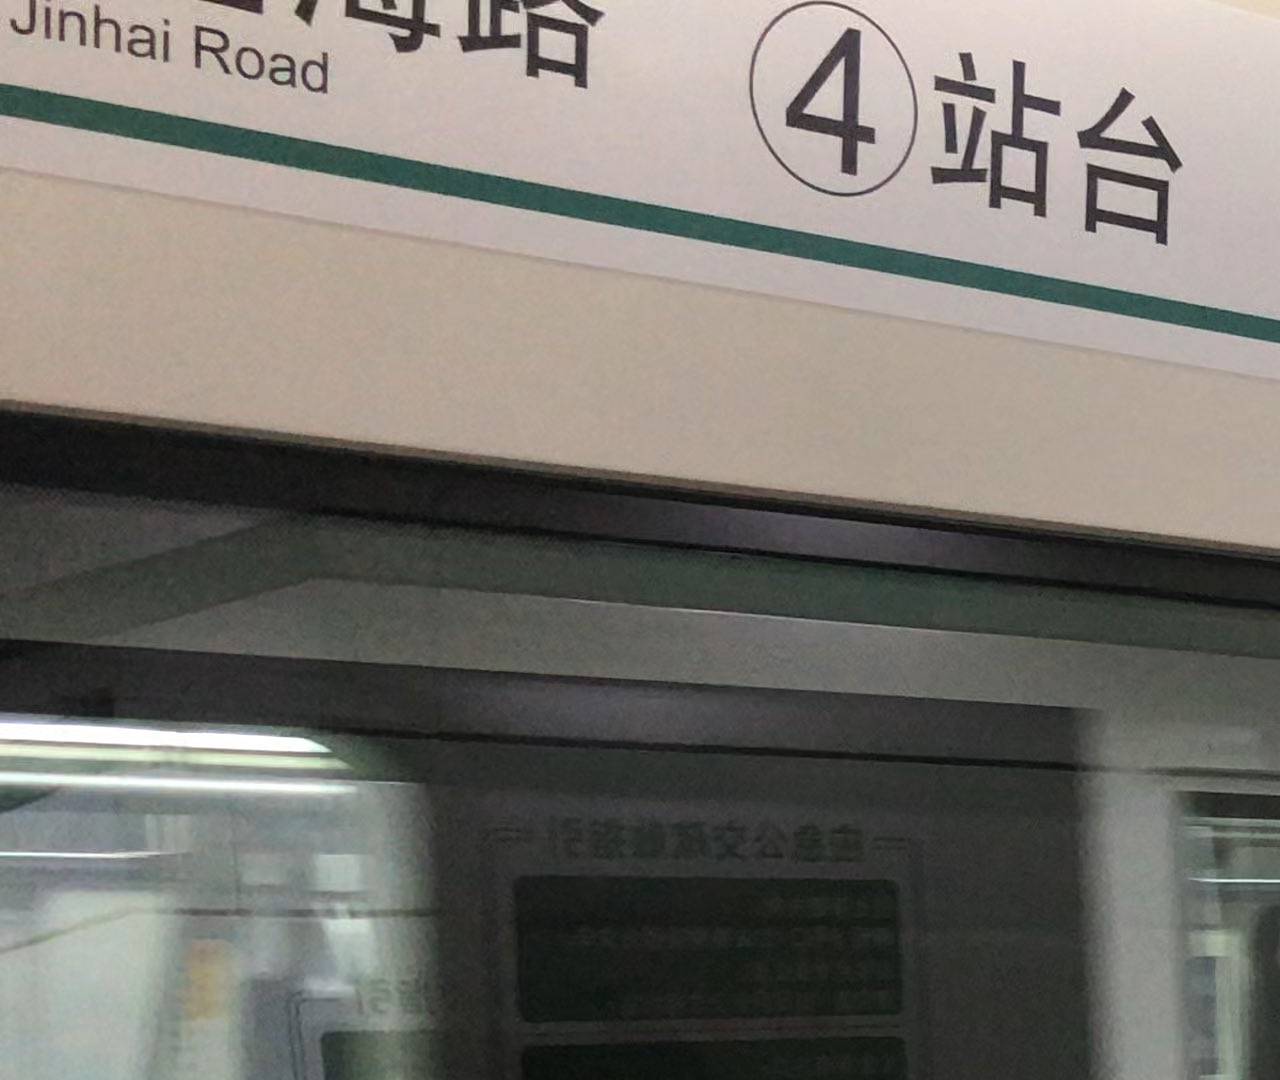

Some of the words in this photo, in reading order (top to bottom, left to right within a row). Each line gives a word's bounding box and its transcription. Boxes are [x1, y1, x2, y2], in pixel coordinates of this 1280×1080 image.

[9, 0, 171, 62] Jinhai
[194, 26, 330, 94] Road
[930, 51, 1183, 245] 站台
